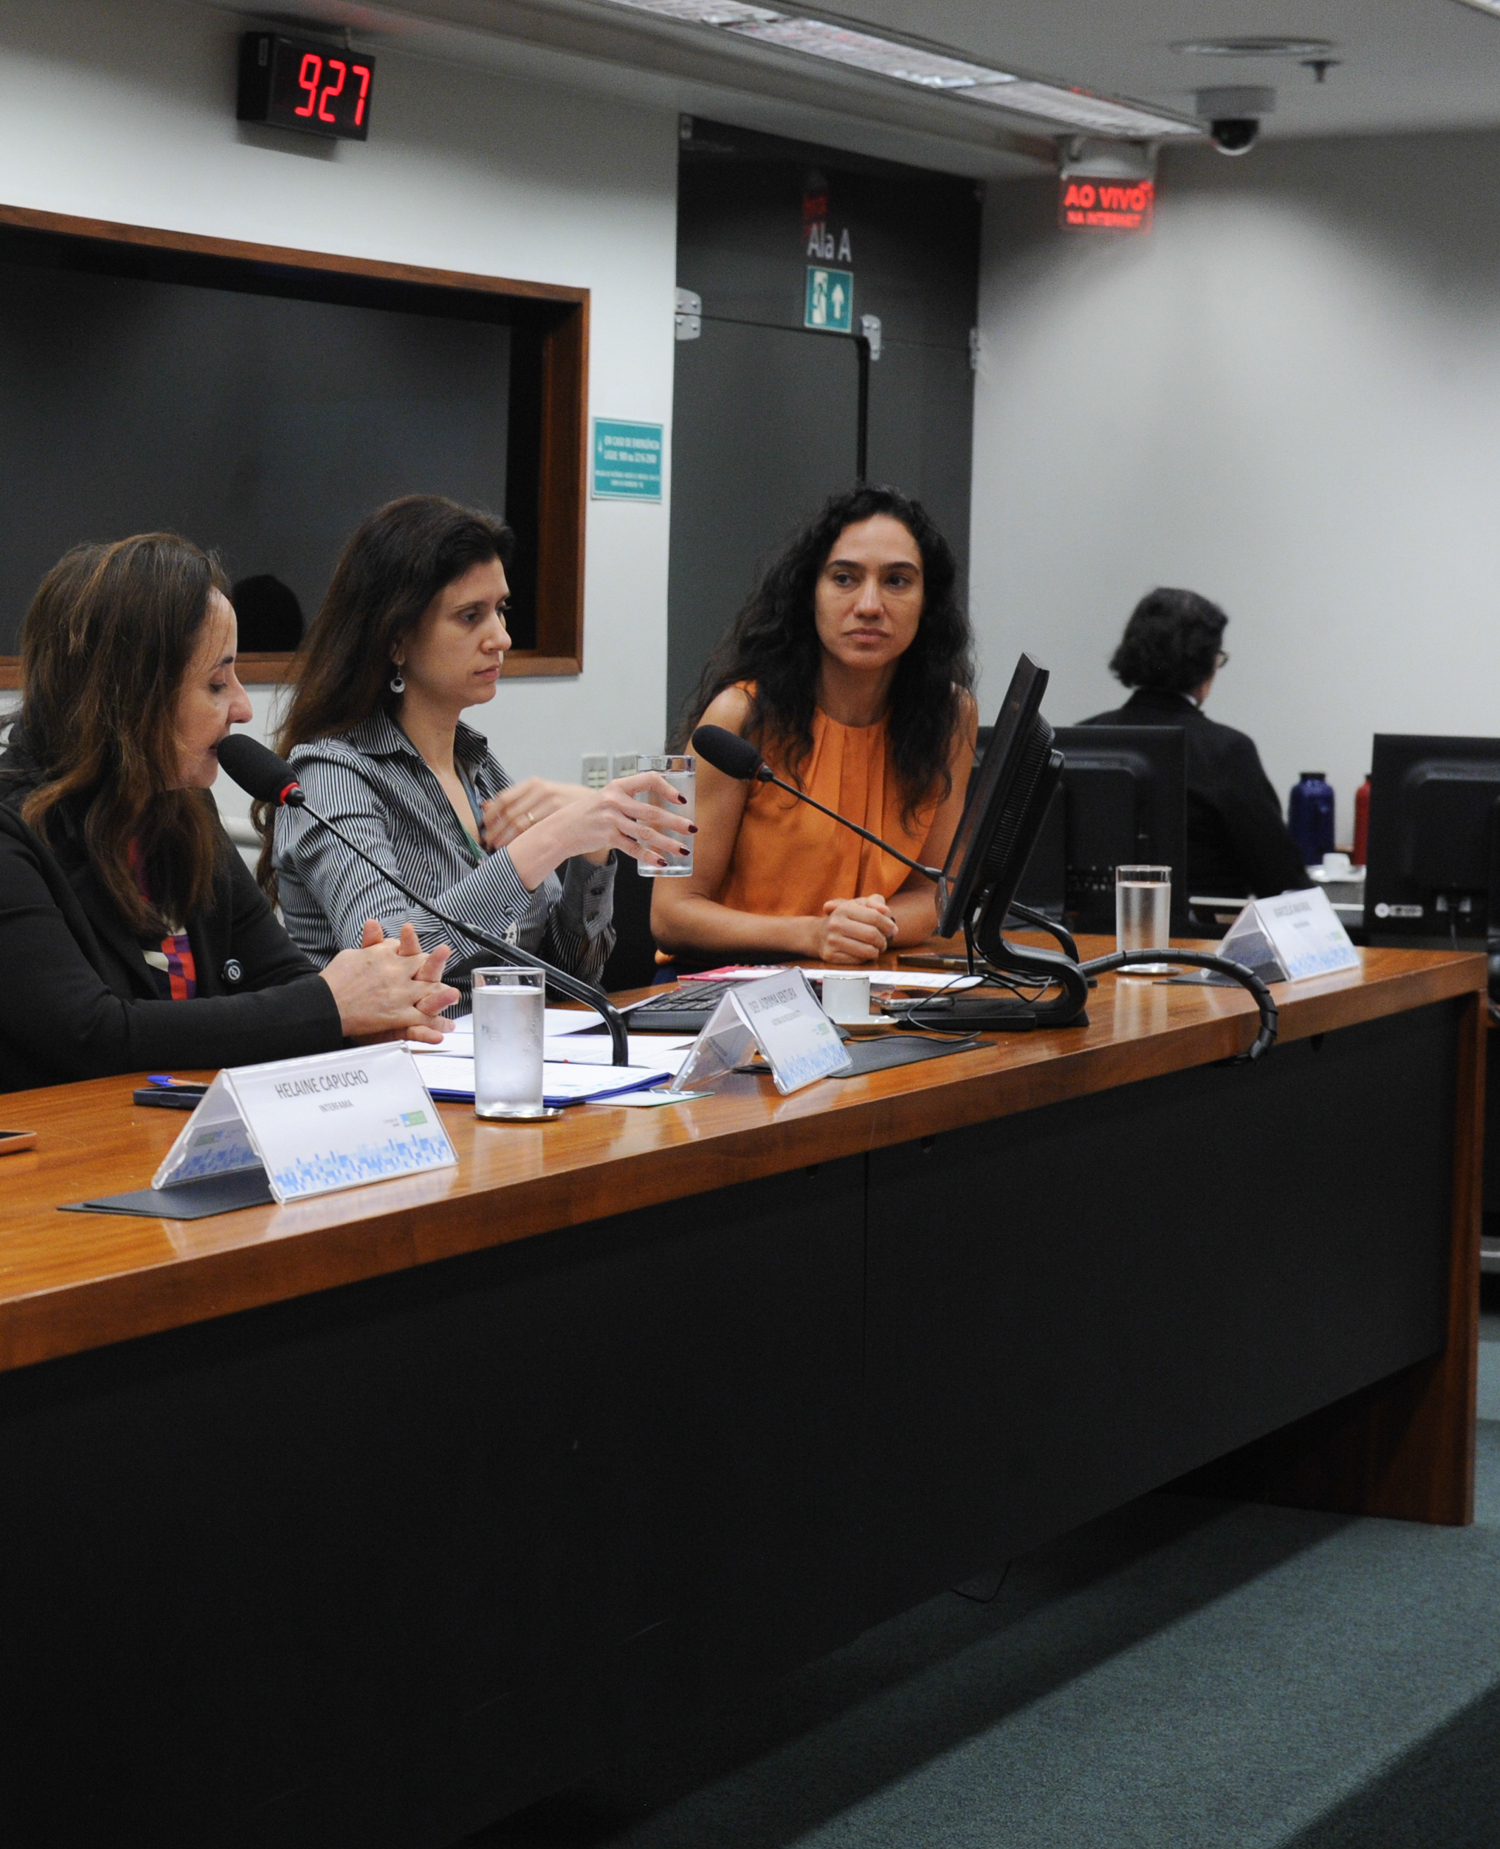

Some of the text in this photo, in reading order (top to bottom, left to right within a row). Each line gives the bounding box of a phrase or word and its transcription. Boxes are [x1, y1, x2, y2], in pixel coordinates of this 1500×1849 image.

[295, 53, 370, 126] 927
[1064, 184, 1147, 211] AO VIVO
[807, 222, 852, 262] Ala A
[275, 1069, 369, 1099] HELAINE CAPUCHO
